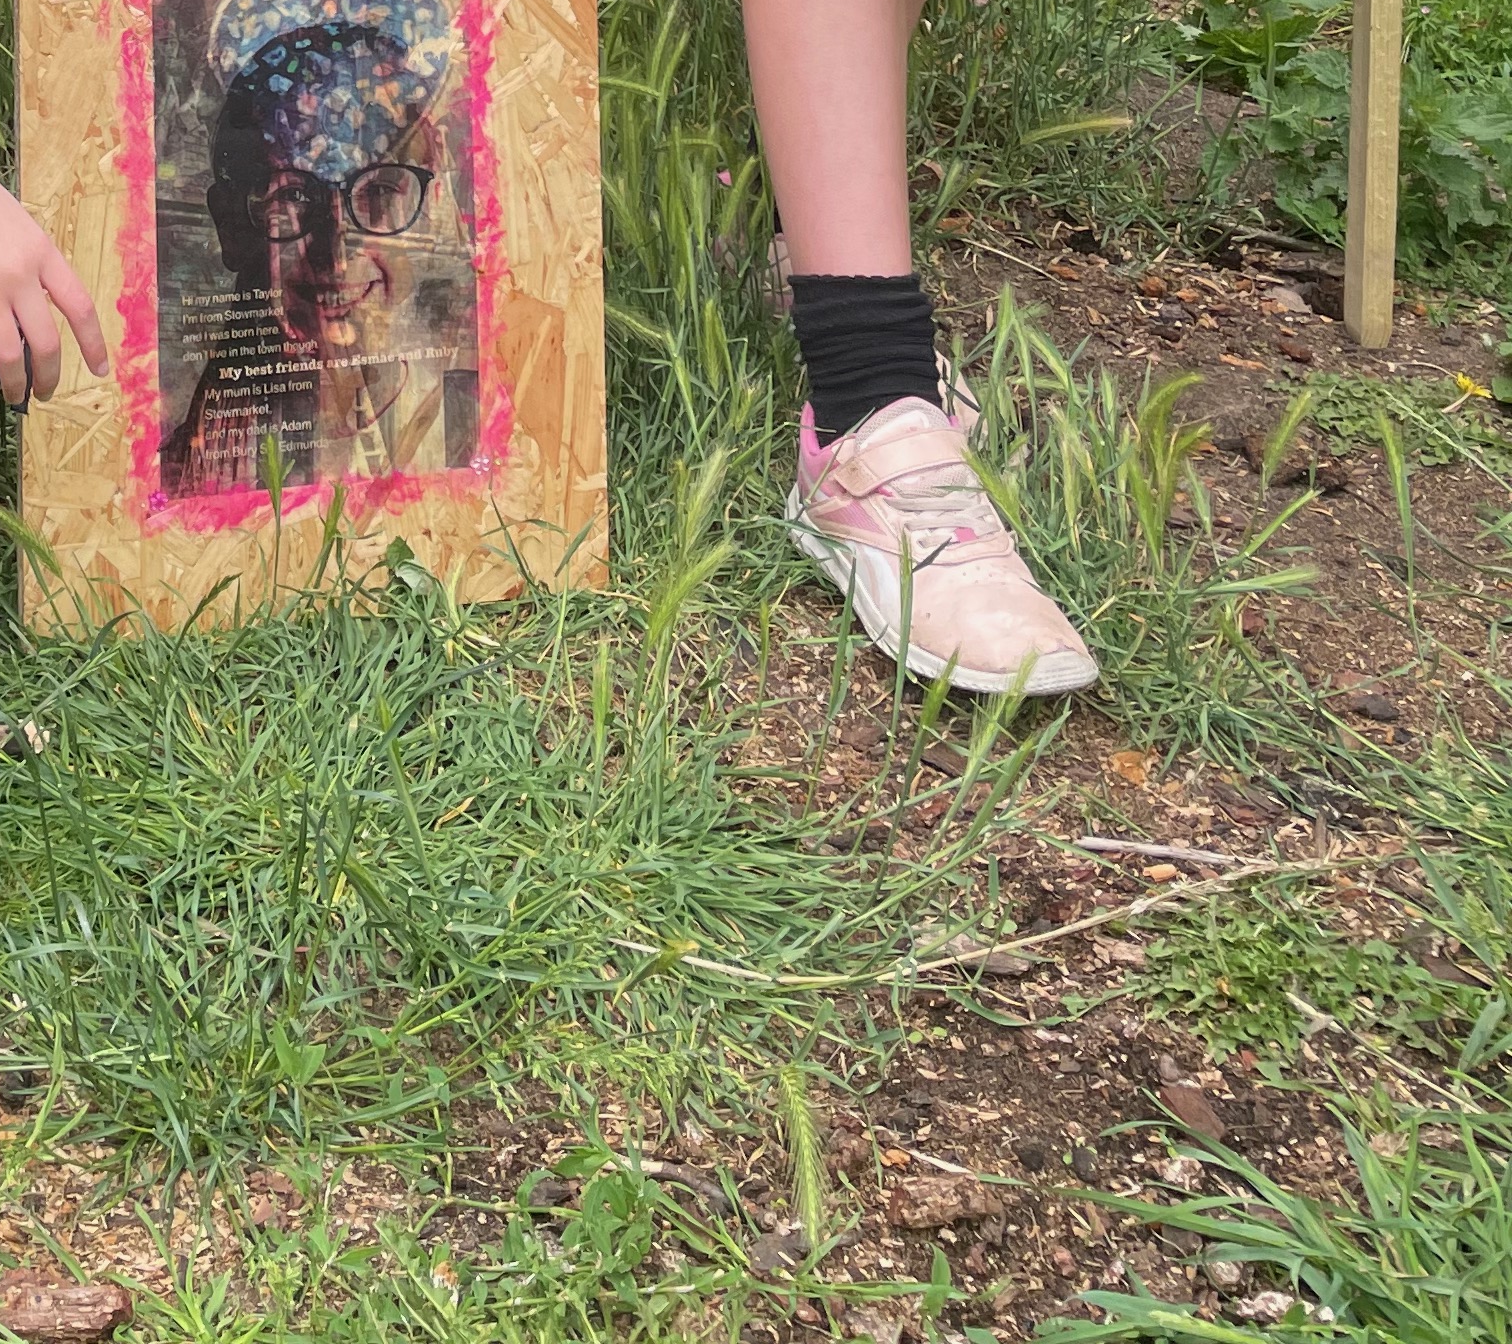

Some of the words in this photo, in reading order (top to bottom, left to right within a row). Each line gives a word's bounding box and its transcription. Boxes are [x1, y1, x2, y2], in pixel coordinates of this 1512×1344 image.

[181, 295, 193, 307] Hi
[194, 295, 211, 307] my
[212, 292, 241, 304] name
[242, 290, 252, 301] is
[253, 288, 283, 302] Taylor
[199, 312, 223, 324] from
[224, 306, 285, 322] Stowmarket
[182, 332, 202, 344] and
[209, 330, 230, 342] was
[231, 327, 255, 339] born
[209, 348, 227, 359] live
[228, 346, 239, 357] in
[240, 345, 255, 356] the
[257, 343, 282, 355] town
[283, 338, 319, 353] though
[219, 367, 243, 381] My
[244, 363, 273, 377] best
[275, 358, 324, 374] friends
[326, 358, 348, 369] are
[349, 354, 395, 366] Esmae
[397, 348, 423, 361] and
[425, 346, 460, 361] Ruby
[204, 388, 222, 402] My
[223, 386, 250, 398] mum
[252, 383, 262, 395] is
[263, 381, 287, 395] Lisa
[288, 379, 313, 392] from
[205, 427, 226, 441] and
[228, 427, 246, 440] my
[246, 422, 267, 436] dad
[269, 423, 279, 433] is
[280, 419, 313, 432] Adam
[205, 447, 230, 461] from
[232, 444, 258, 459] Bury
